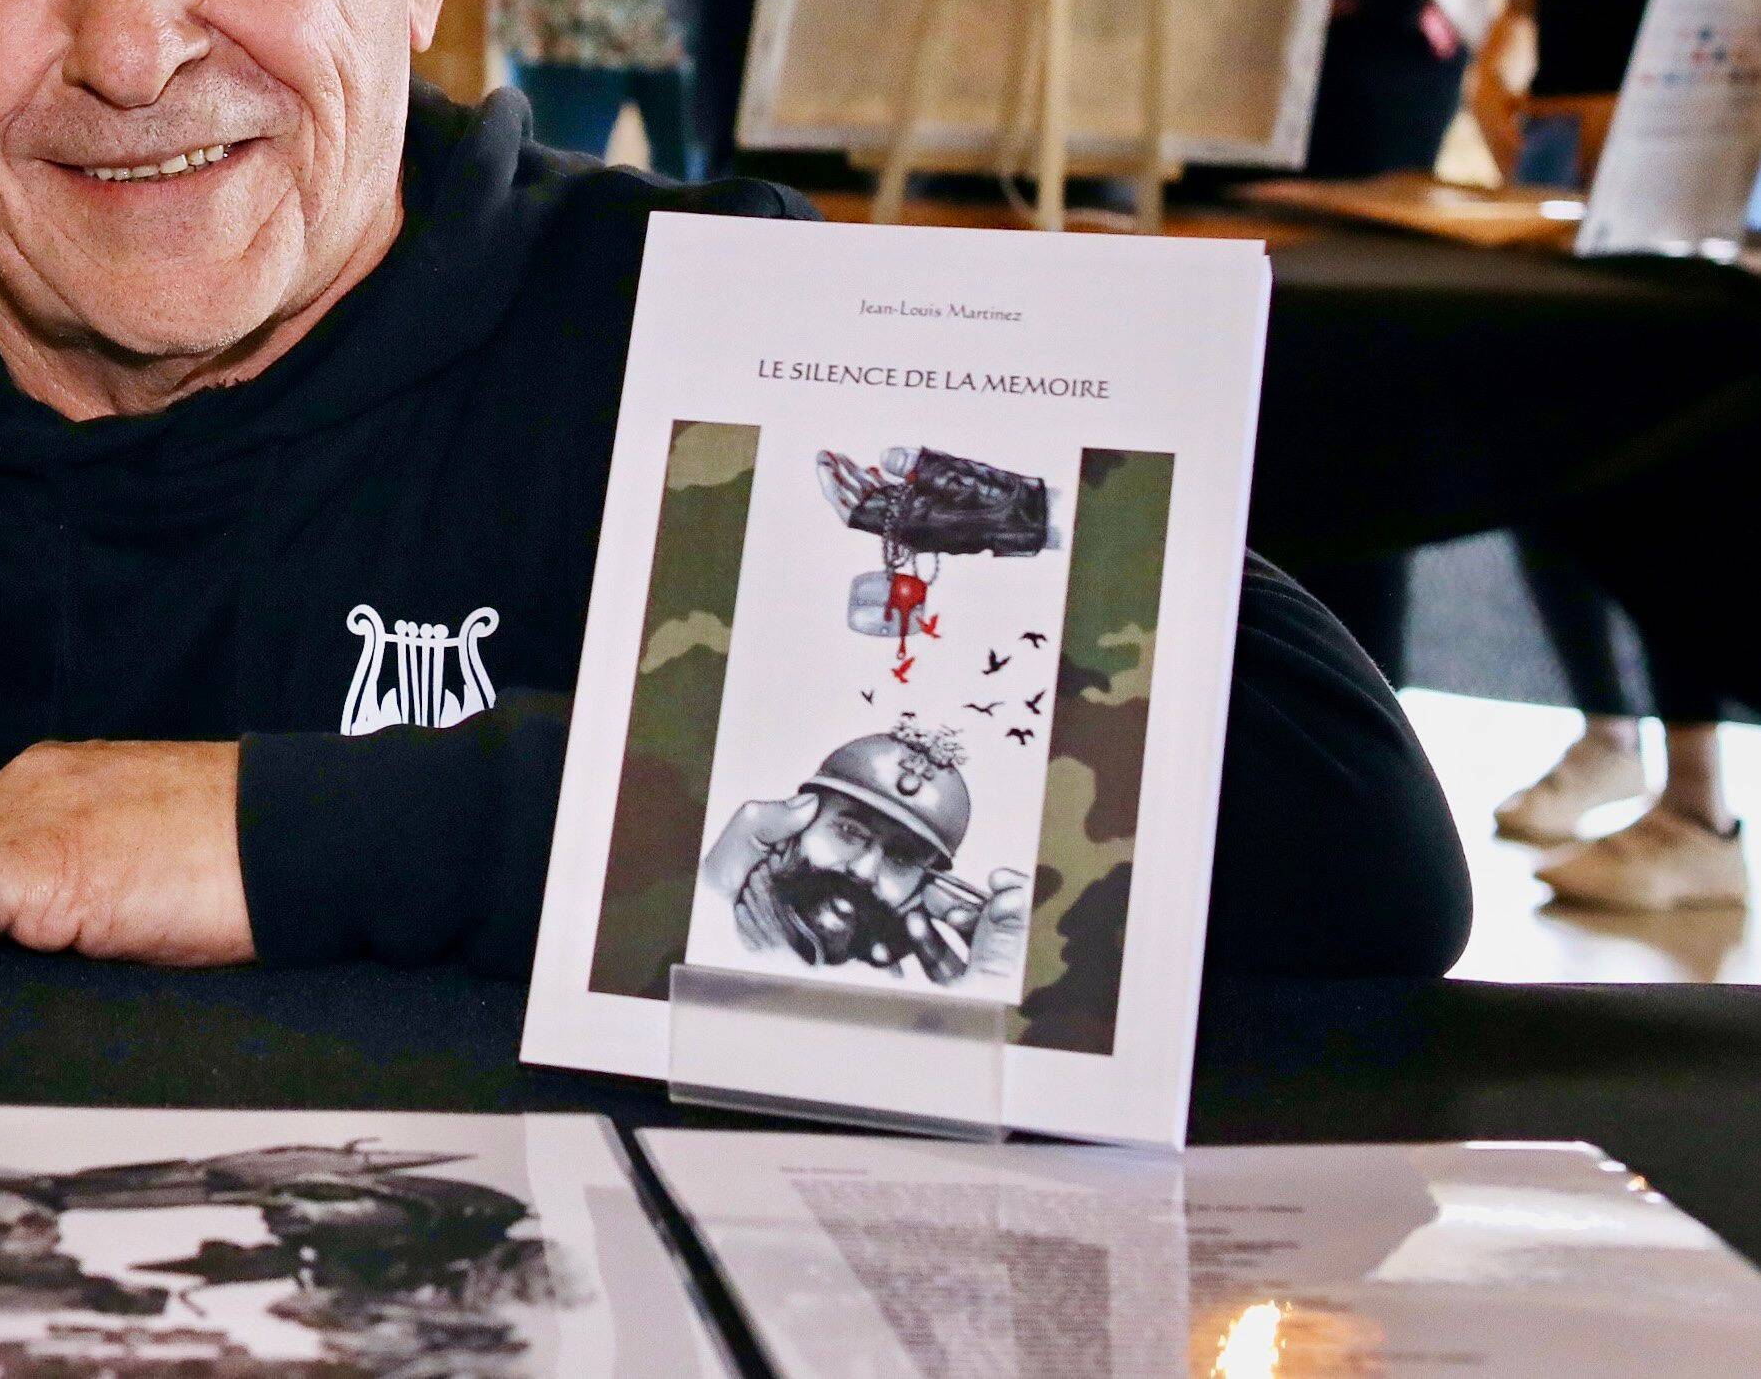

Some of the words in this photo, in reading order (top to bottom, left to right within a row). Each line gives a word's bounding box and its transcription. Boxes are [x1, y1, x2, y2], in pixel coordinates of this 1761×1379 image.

[859, 300, 943, 318] Jean-Louis
[950, 304, 1023, 323] Martinez
[758, 359, 785, 381] LE
[790, 362, 899, 388] SILENCE
[904, 370, 939, 391] DE
[945, 371, 978, 393] LA
[980, 374, 1111, 401] MEMOIRE
